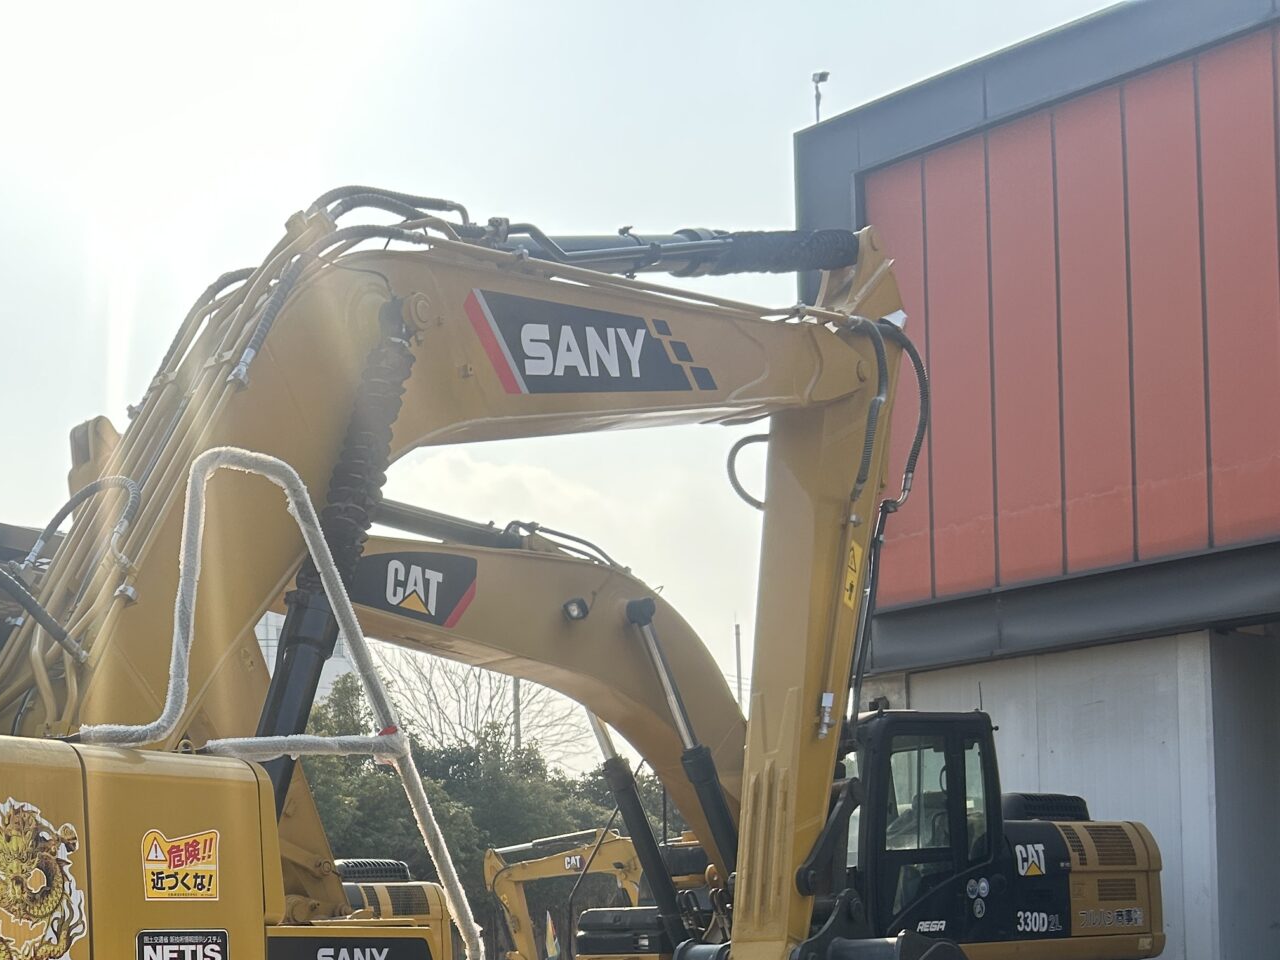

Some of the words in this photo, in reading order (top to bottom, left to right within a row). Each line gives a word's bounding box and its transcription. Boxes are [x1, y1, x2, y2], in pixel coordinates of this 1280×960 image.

[520, 322, 646, 378] SANY
[386, 559, 443, 616] CAT
[564, 855, 581, 870] CAT
[1015, 843, 1046, 876] CAT
